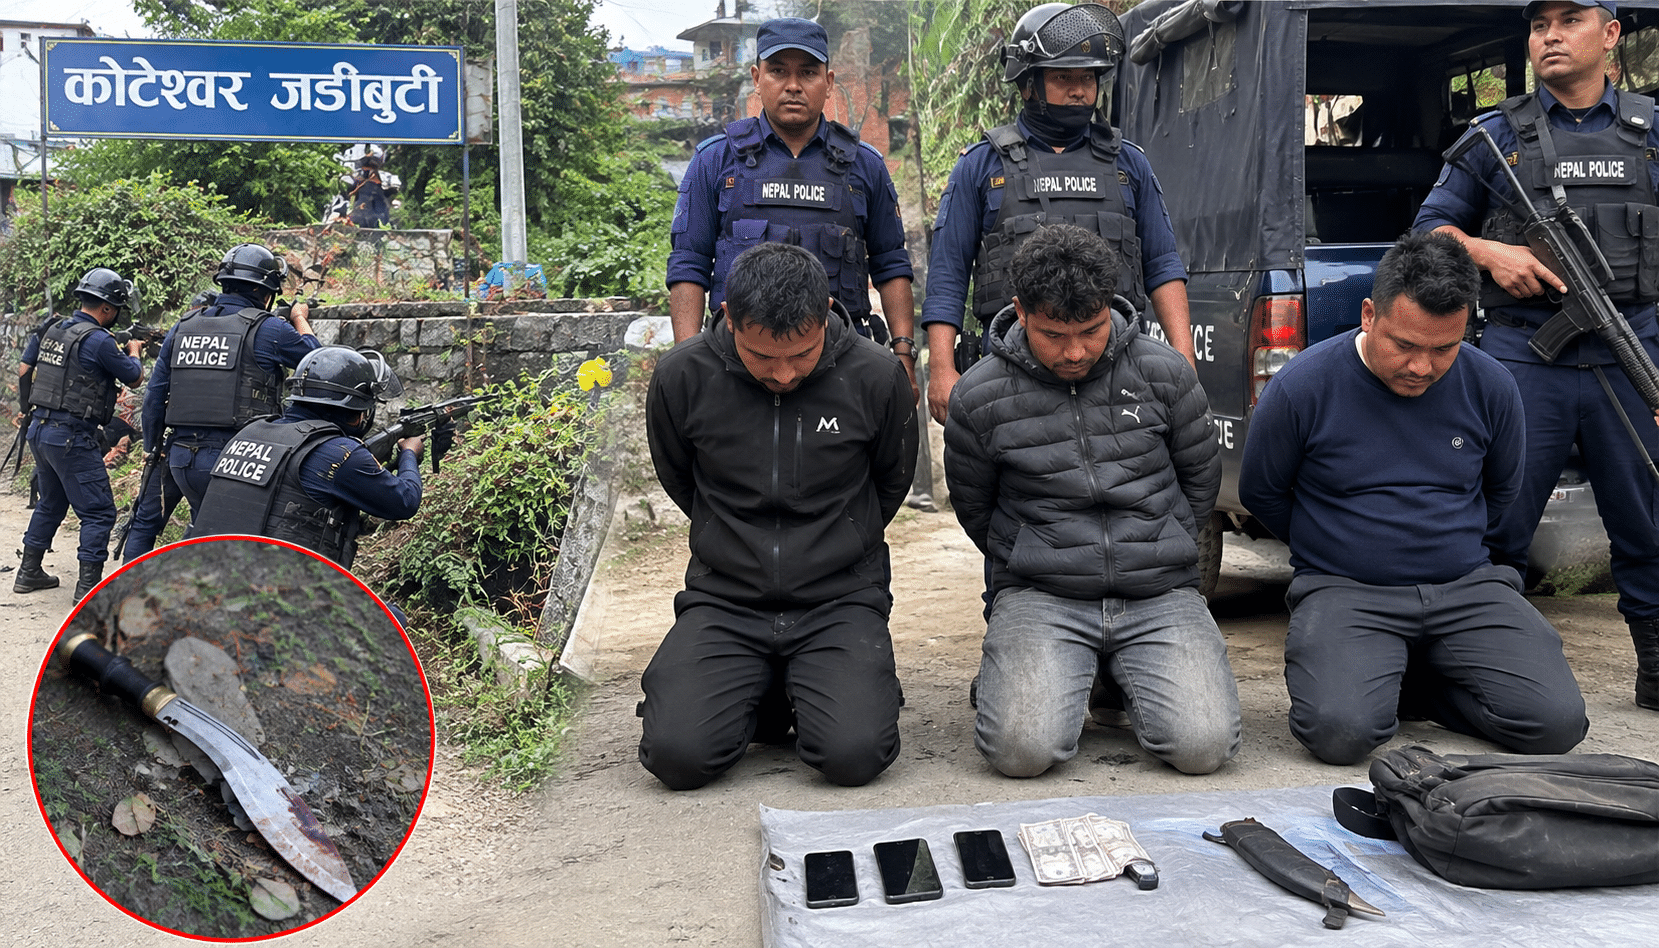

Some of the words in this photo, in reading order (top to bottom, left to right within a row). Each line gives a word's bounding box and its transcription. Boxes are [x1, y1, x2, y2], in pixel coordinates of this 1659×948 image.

[63, 56, 251, 111] कोटेश्वर
[269, 61, 443, 124] जडीबुटी
[1553, 161, 1586, 178] NEPAL
[1589, 161, 1625, 178] POLICE
[762, 183, 790, 199] NEPAL
[794, 184, 825, 202] POLICE
[1033, 177, 1062, 193] NEPAL
[1065, 177, 1097, 192] POLICE
[180, 336, 230, 350] NEPAL
[176, 351, 229, 366] POLICE
[225, 440, 273, 462] NEPAL
[214, 457, 267, 481] POLICE
